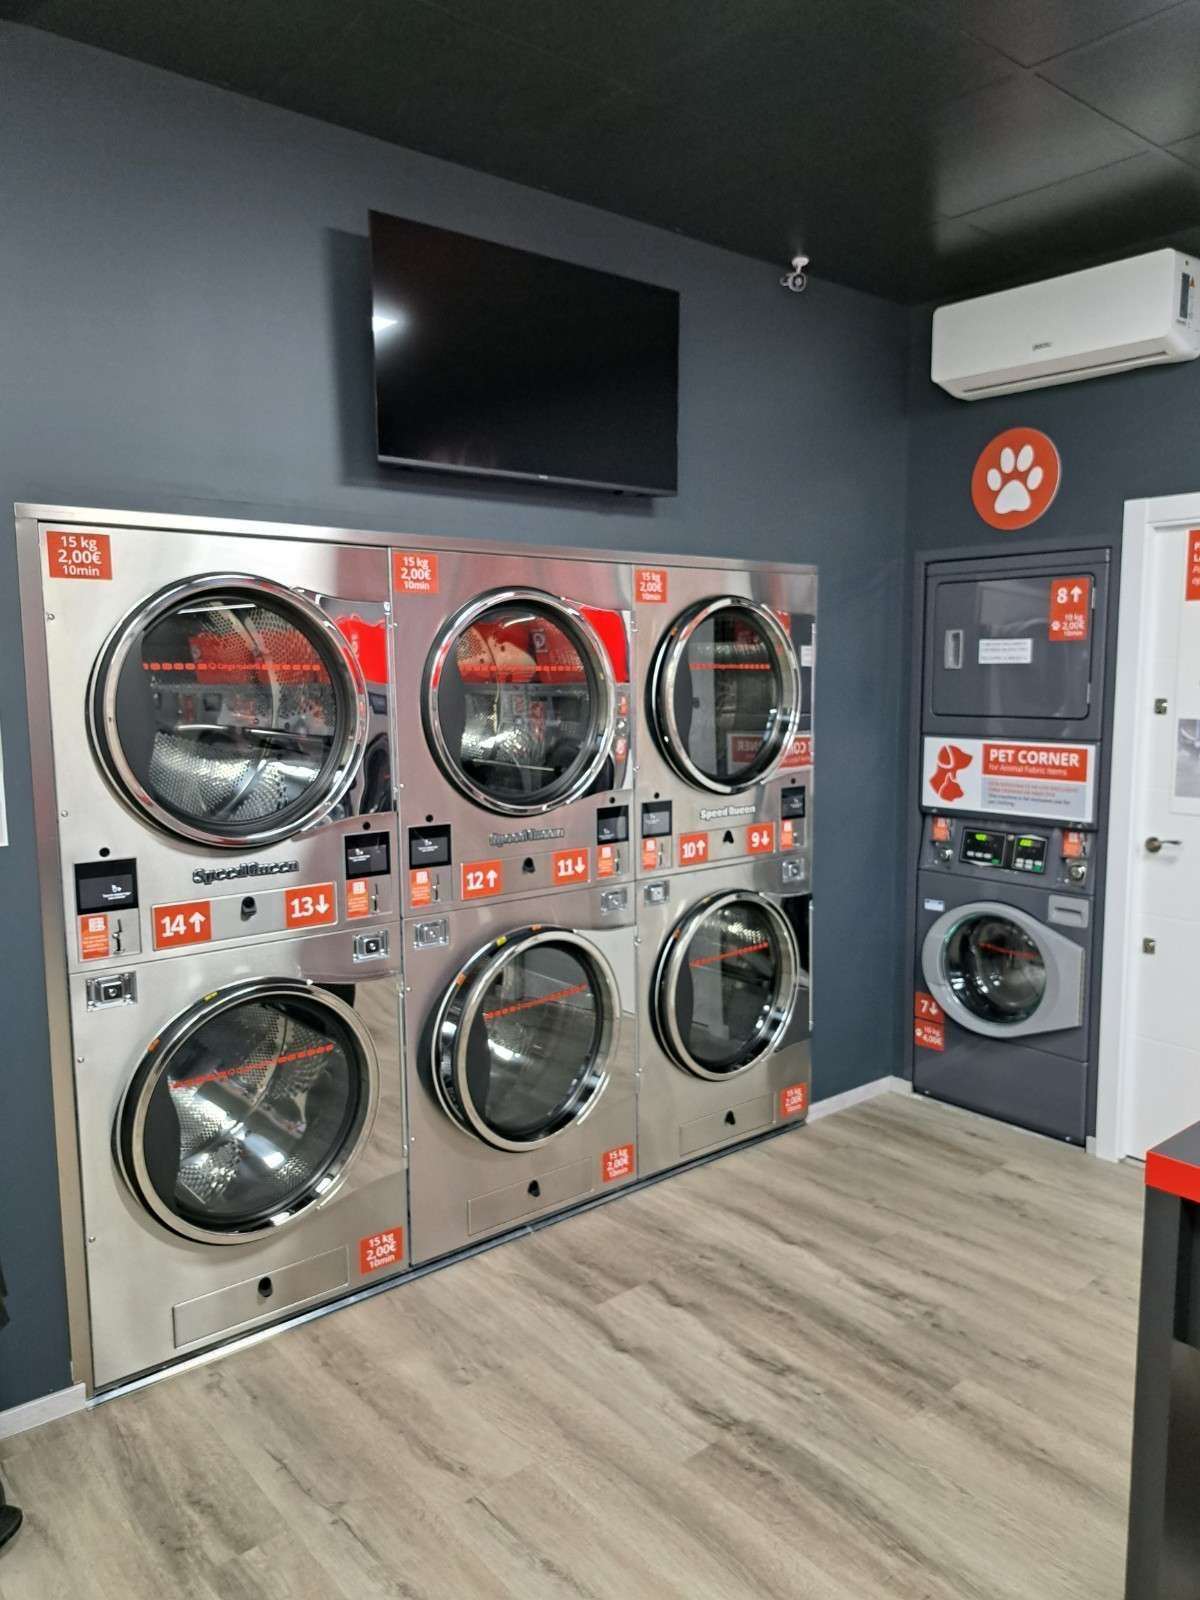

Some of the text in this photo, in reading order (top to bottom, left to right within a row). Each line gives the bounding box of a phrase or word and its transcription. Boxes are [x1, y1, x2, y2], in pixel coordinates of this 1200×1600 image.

[60, 535, 98, 552] 15 kg
[57, 549, 102, 565] 2,00€
[403, 556, 429, 570] 15 kg
[62, 565, 100, 577] 10min
[400, 566, 432, 581] 2,00€
[641, 571, 651, 581] 15
[403, 580, 430, 591] 10min
[1056, 587, 1069, 604] 8
[989, 748, 1080, 768] PET CORNER
[699, 804, 757, 821] Speed Queen
[750, 831, 760, 849] 9
[682, 842, 697, 859] 10
[556, 857, 574, 878] 11
[465, 870, 484, 891] 12
[290, 896, 315, 919] 13
[160, 914, 187, 938] 14
[919, 999, 930, 1014] 7
[368, 1232, 394, 1248] 15 kg
[366, 1240, 397, 1262] 2,00€
[369, 1254, 396, 1269] 10min
